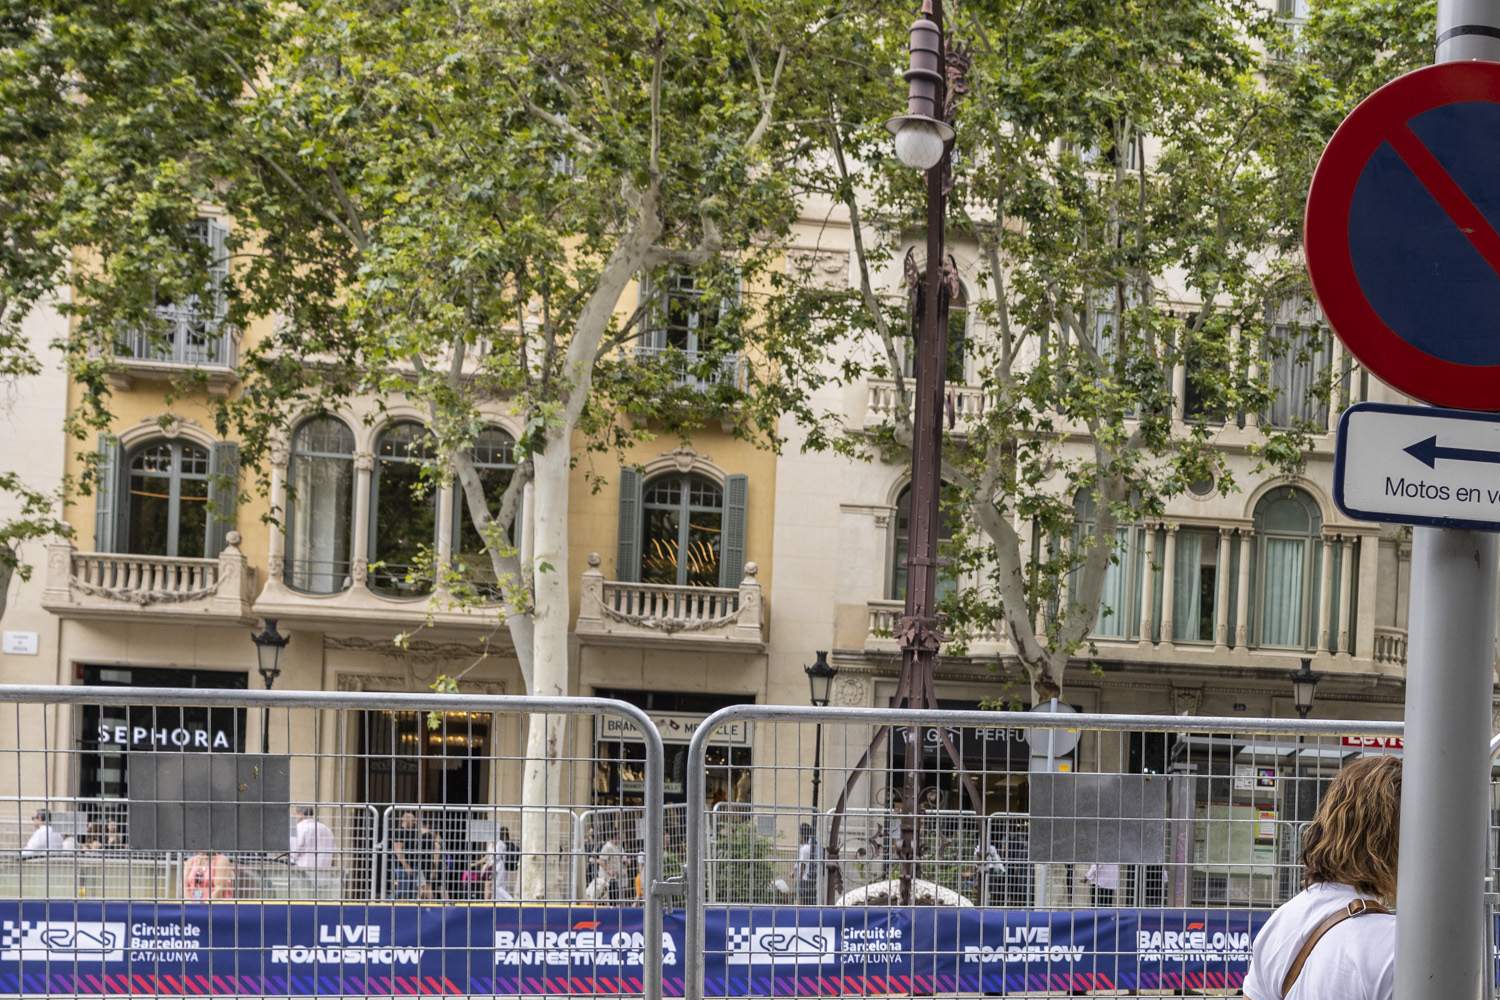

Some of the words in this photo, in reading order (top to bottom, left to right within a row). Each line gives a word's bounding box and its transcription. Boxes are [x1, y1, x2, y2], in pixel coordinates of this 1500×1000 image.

[1385, 476, 1450, 501] Motos
[1456, 486, 1481, 503] en
[608, 720, 637, 732] BRAN
[97, 724, 229, 748] SEPHORA
[975, 727, 1025, 742] PERFU
[132, 923, 181, 936] Circuit
[183, 923, 200, 936] de
[320, 925, 380, 943] LIVE
[842, 927, 885, 939] Circuit
[887, 927, 902, 939] de
[1005, 927, 1049, 943] LIVE
[131, 938, 200, 950] Barcelona
[494, 931, 677, 952] BARCELONA
[841, 940, 902, 952] Barcelona
[1137, 931, 1253, 949] BARCELONA
[130, 951, 199, 963] CATALUNYA
[272, 945, 424, 964] ROADSHOW
[494, 951, 532, 965] FAN
[535, 951, 623, 966] FESTIVAL
[841, 953, 903, 964] CATALUNYA
[964, 945, 1085, 962] ROADSHOW
